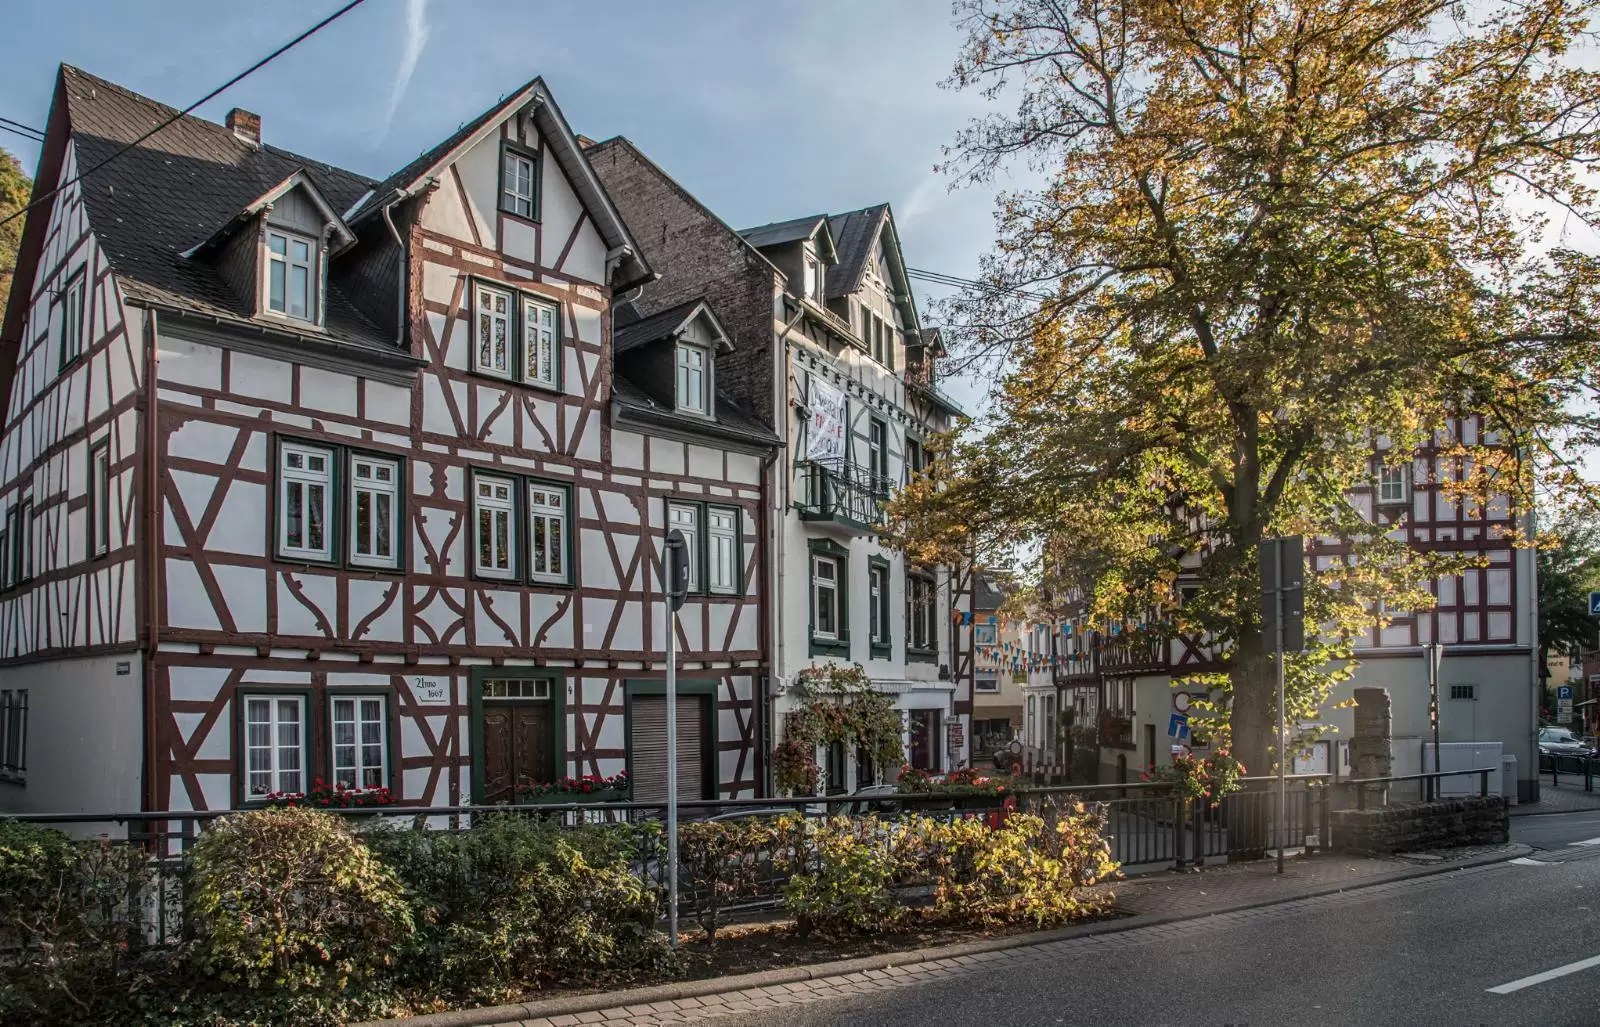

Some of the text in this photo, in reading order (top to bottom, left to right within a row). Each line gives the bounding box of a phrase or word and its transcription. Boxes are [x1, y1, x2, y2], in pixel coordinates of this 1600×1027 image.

[415, 677, 437, 689] Anno
[427, 689, 444, 698] 1669
[568, 685, 573, 695] 4
[1560, 687, 1569, 698] P
